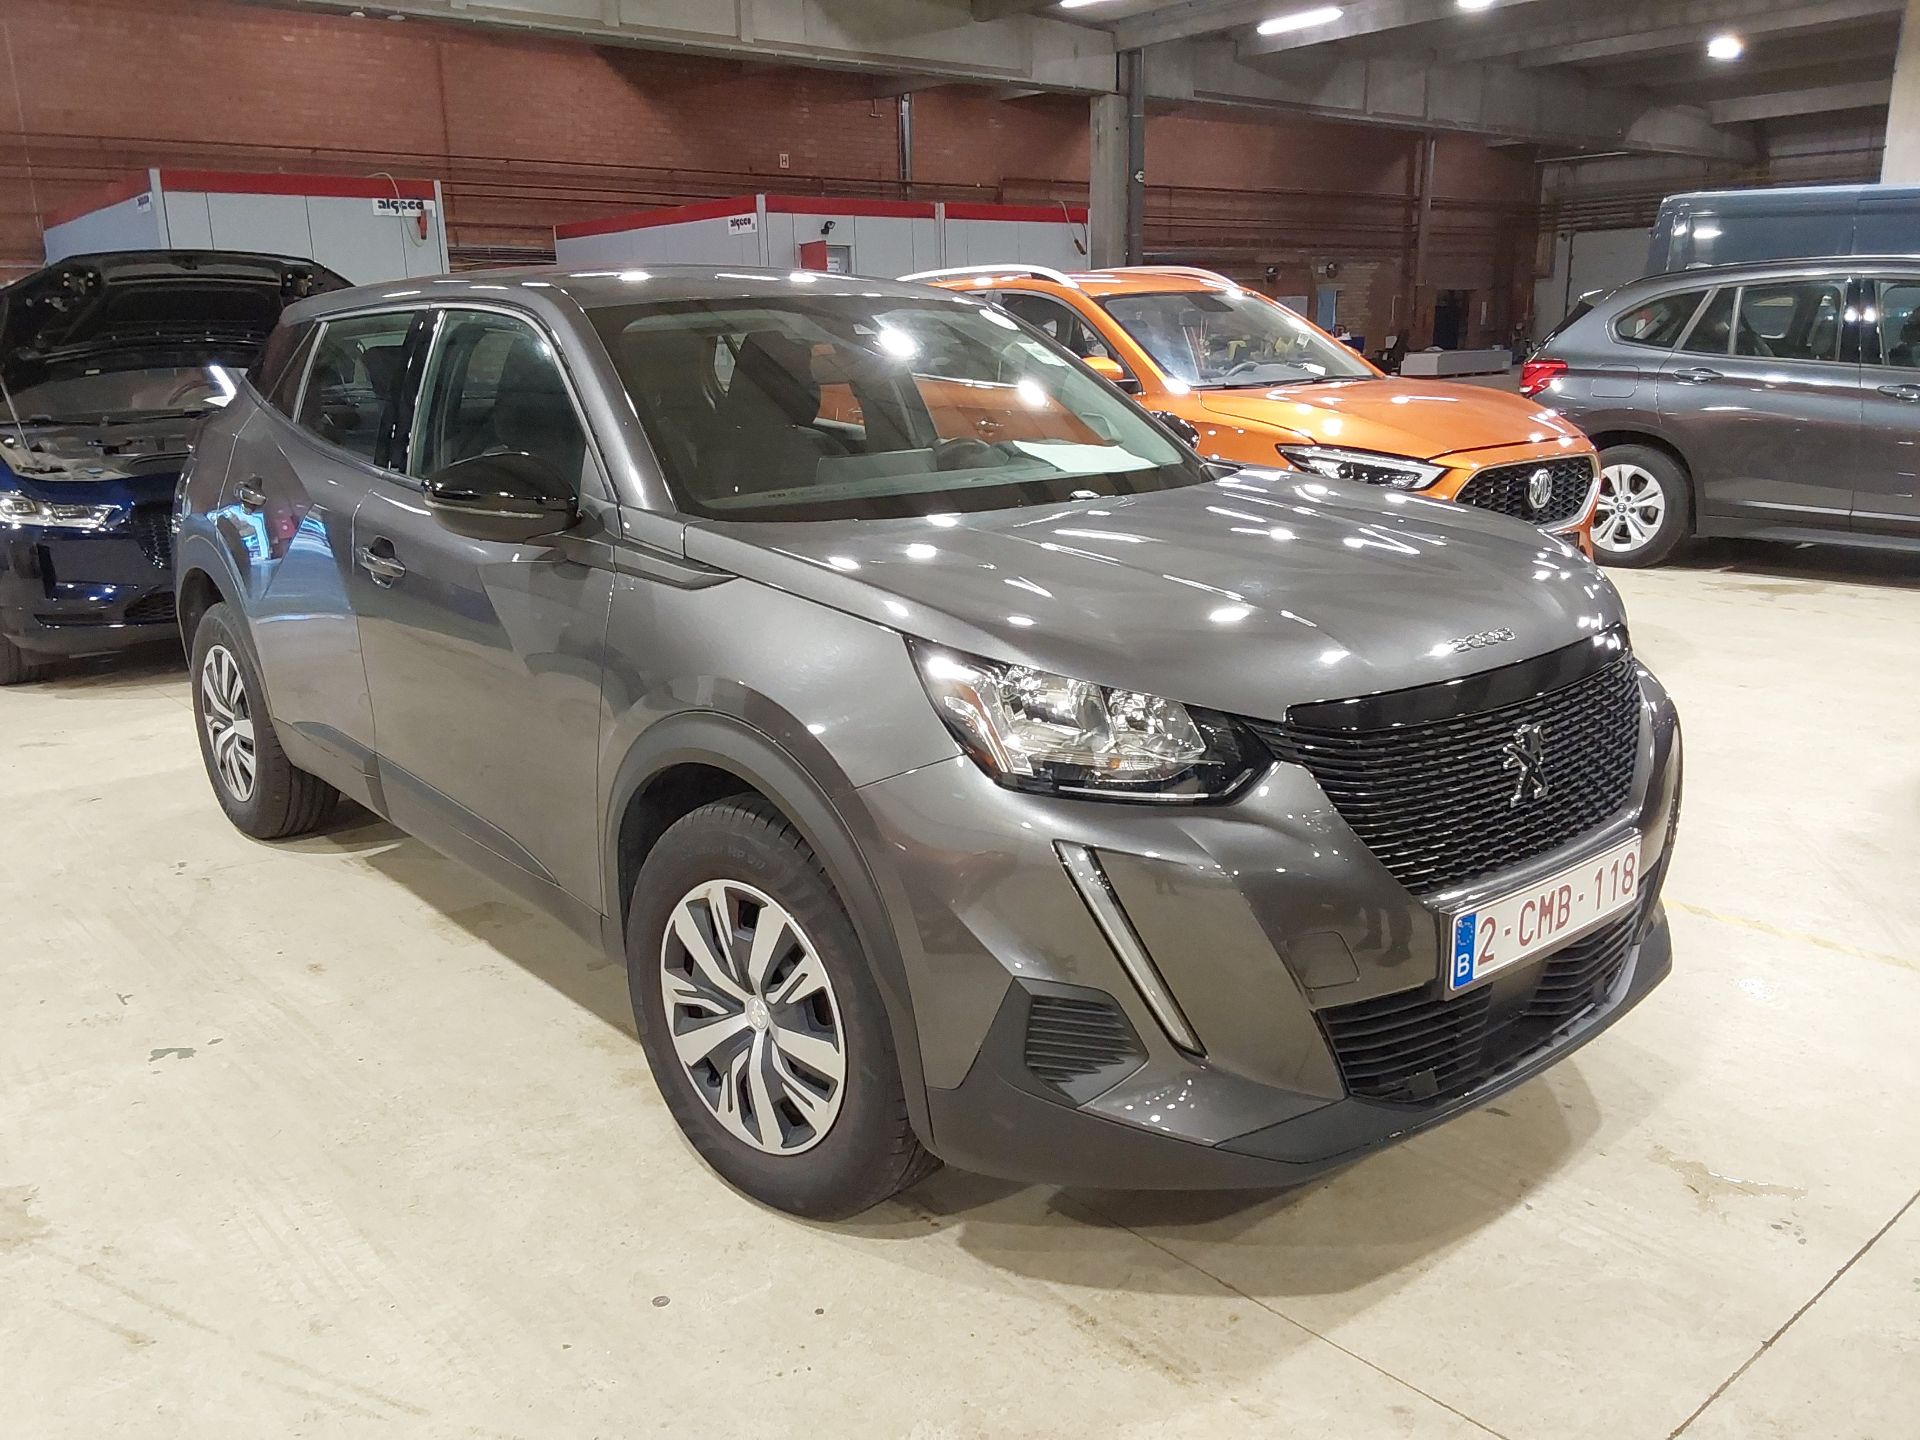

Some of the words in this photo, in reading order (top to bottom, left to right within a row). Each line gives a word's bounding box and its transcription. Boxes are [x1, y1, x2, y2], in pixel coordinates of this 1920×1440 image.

[378, 199, 424, 214] algeco
[1477, 851, 1636, 967] 2-CMB-118
[1457, 952, 1470, 978] B
